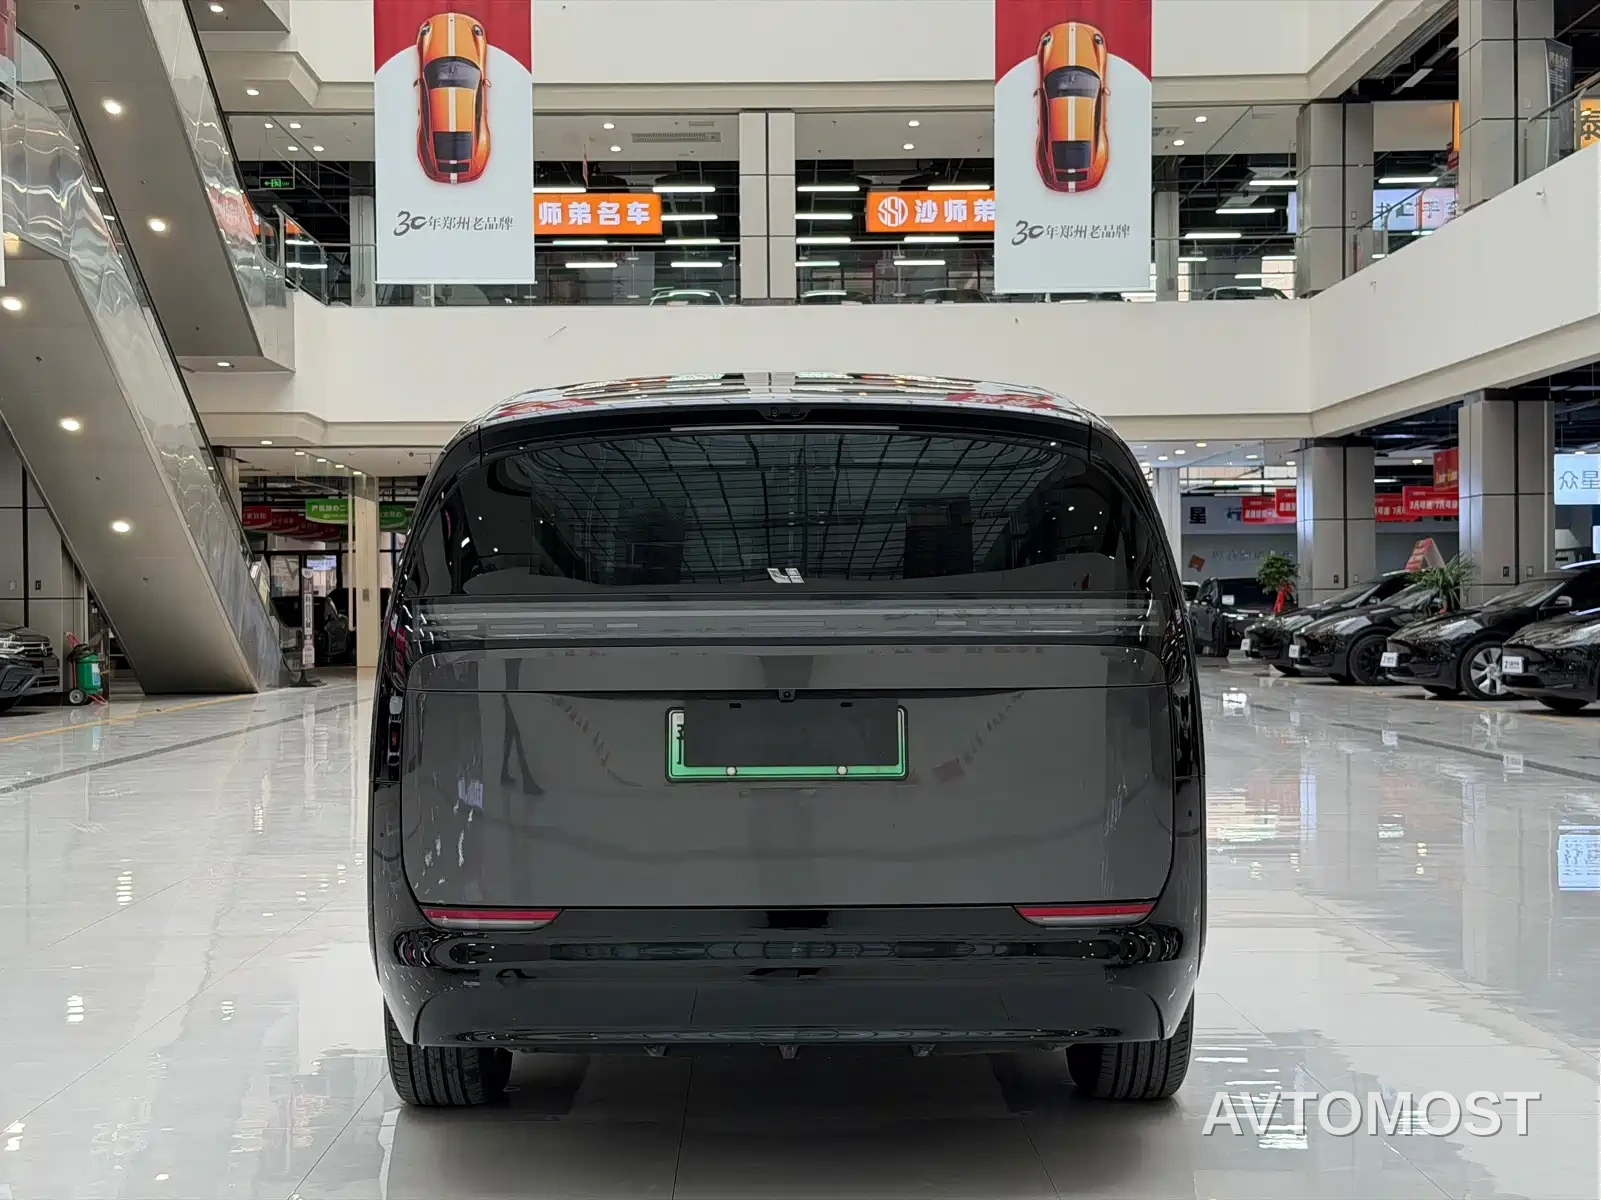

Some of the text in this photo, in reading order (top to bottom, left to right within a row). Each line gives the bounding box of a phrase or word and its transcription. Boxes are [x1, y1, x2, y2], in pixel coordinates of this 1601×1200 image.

[538, 201, 651, 225] 师弟名车
[1559, 470, 1600, 490] 众星
